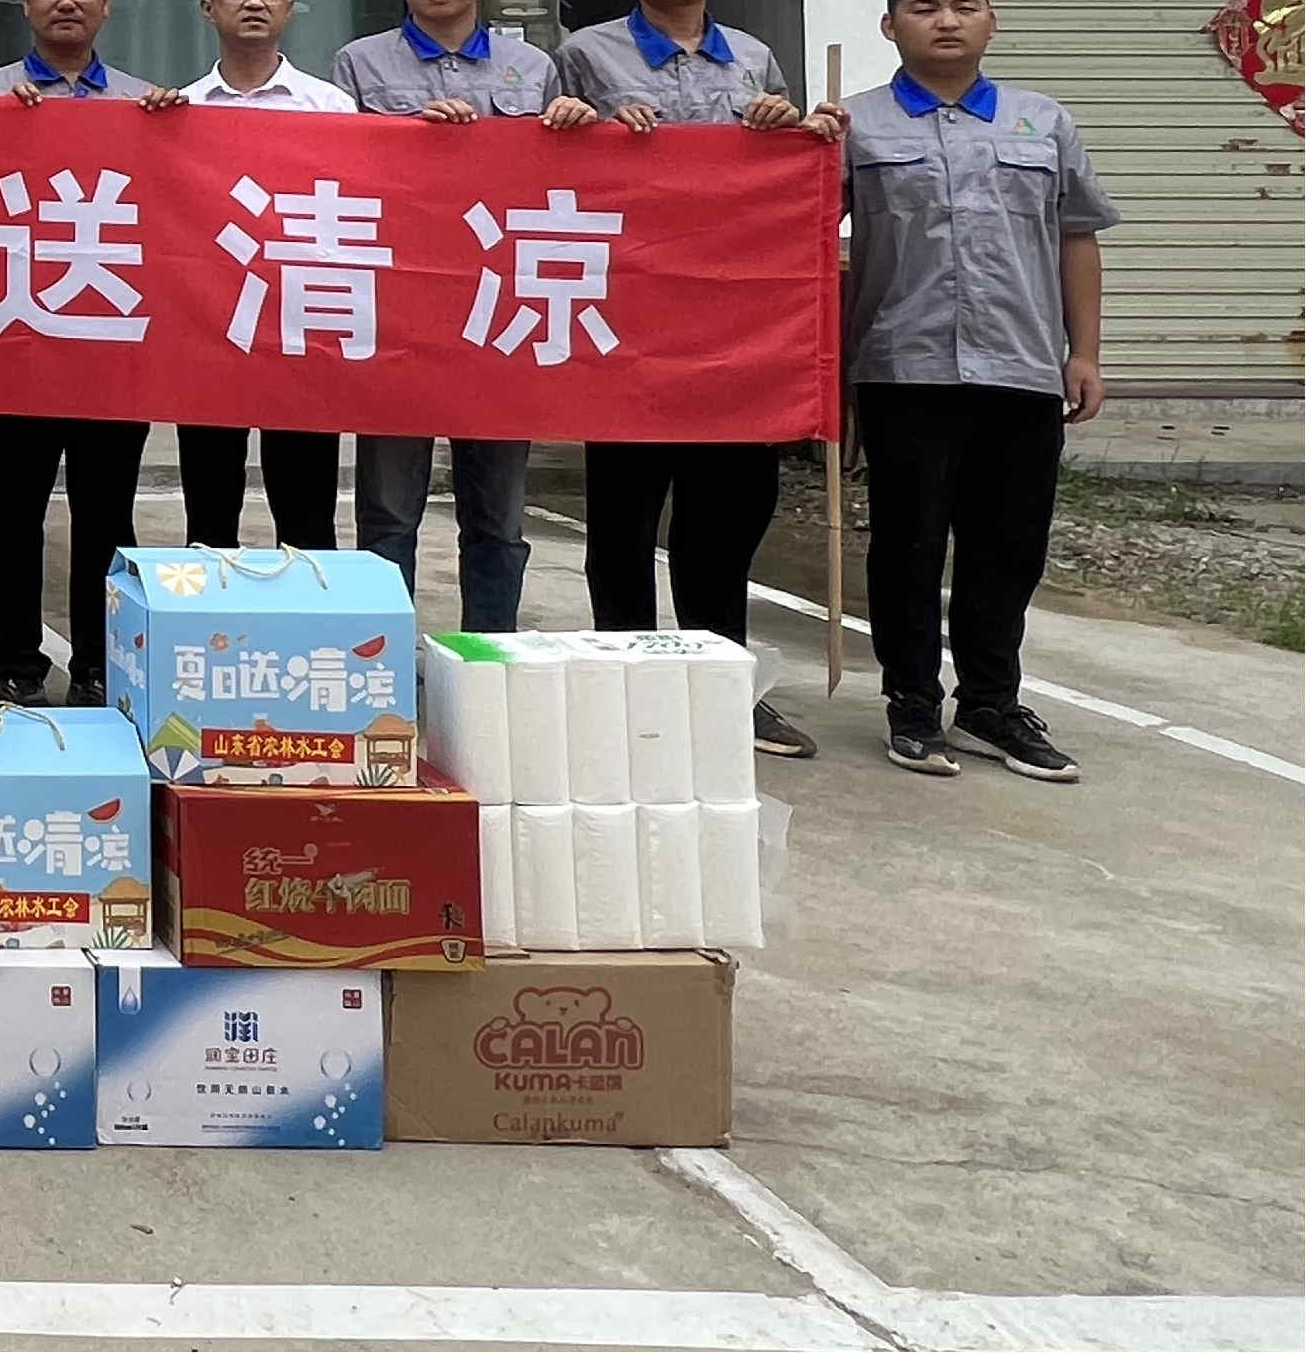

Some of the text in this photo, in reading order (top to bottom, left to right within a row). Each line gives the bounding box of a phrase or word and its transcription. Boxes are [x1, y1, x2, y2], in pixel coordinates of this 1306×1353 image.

[173, 645, 397, 713] 夏日送清凉
[212, 732, 346, 761] 山东省农林水工会
[242, 847, 315, 876] 统一
